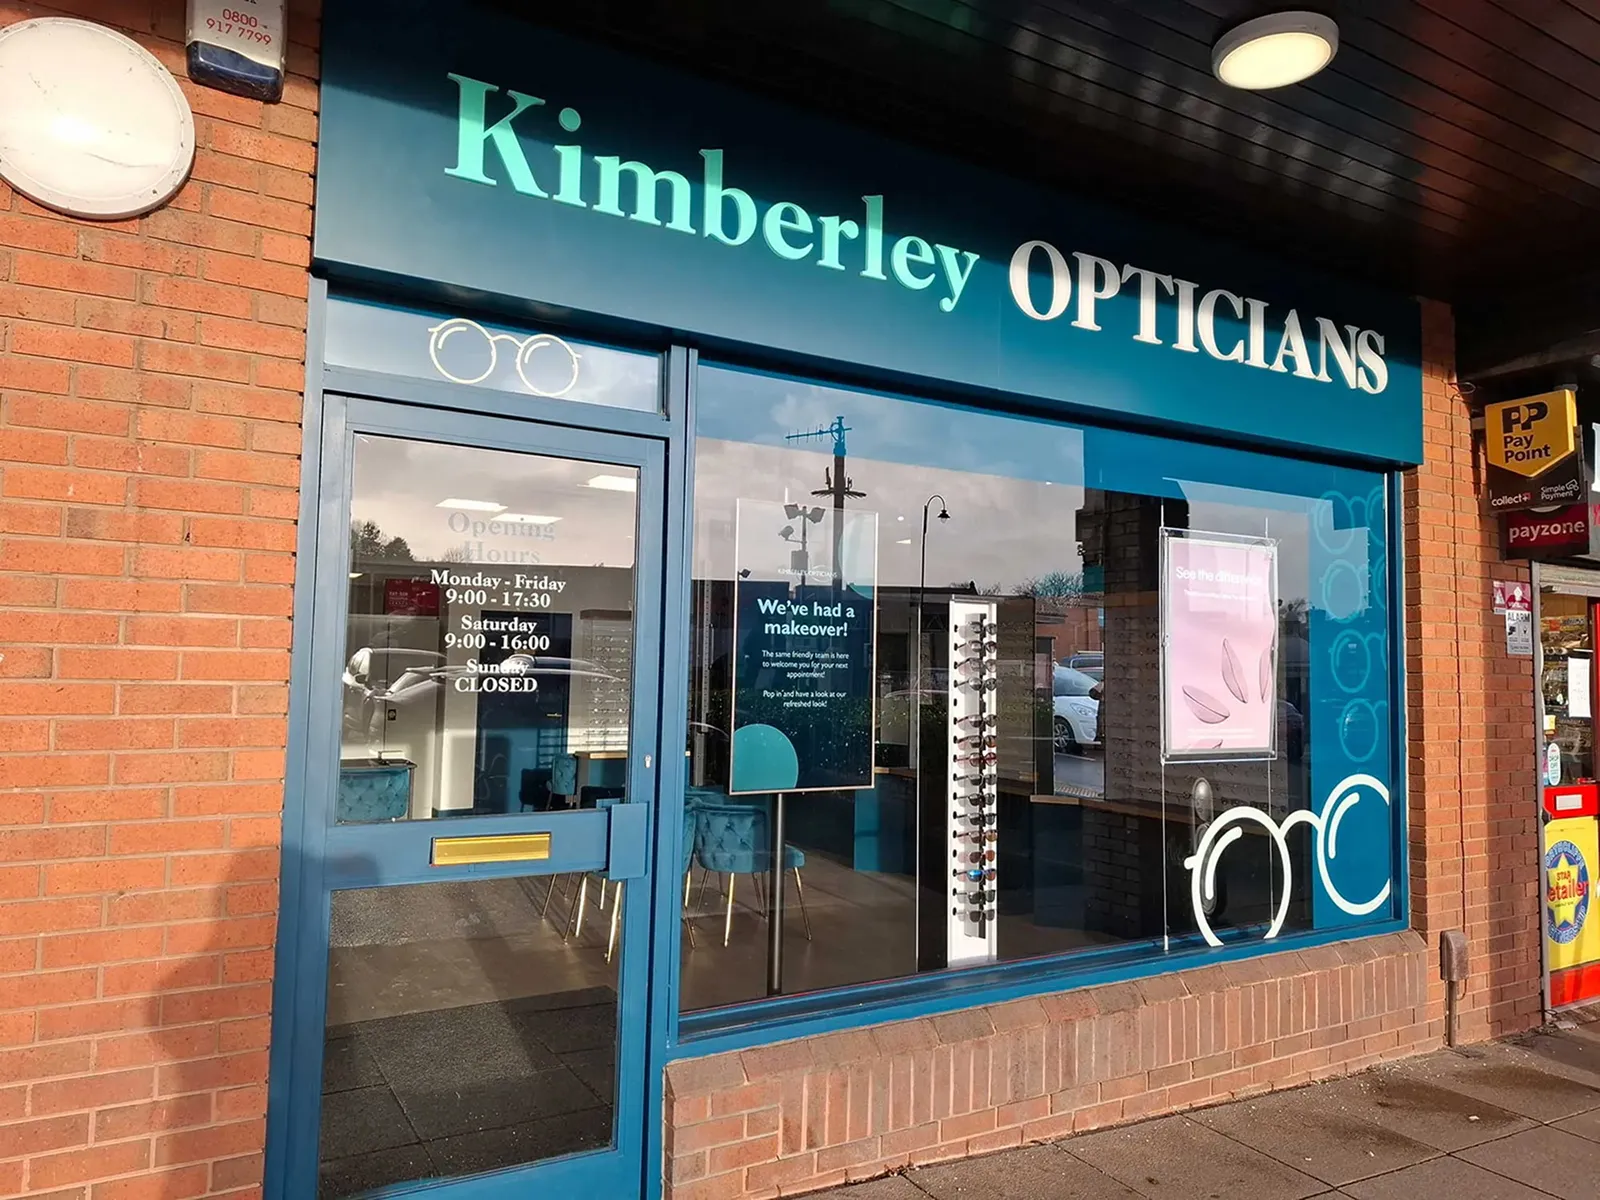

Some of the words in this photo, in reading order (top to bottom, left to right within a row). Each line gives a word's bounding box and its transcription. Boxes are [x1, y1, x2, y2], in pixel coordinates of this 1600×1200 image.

[223, 8, 258, 28] 0800
[206, 18, 232, 35] 917
[238, 27, 272, 45] 7799
[444, 72, 980, 312] Kimberley
[1009, 239, 1389, 394] OPTICIANS
[1503, 434, 1534, 450] Pay
[1505, 445, 1551, 463] Point
[1541, 484, 1565, 493] Simple
[1541, 490, 1573, 501] Payment
[448, 511, 557, 541] Opening
[1509, 521, 1585, 543] payzone
[464, 540, 541, 564] Hours
[430, 569, 502, 589] Monday
[515, 574, 566, 593] Friday
[1175, 566, 1197, 580] See
[1198, 568, 1213, 582] the
[445, 589, 487, 605] 9:00
[502, 592, 551, 608] 17:30
[813, 601, 841, 617] had
[845, 607, 855, 618] a
[461, 614, 537, 634] Saturday
[764, 620, 848, 637] makeover!
[444, 633, 486, 649] 9:00
[501, 635, 550, 650] 16:00
[762, 649, 774, 658] The
[792, 650, 813, 660] friendly
[830, 651, 835, 659] is
[836, 651, 850, 660] here
[466, 658, 530, 676] Sunday
[798, 662, 810, 670] you
[811, 661, 820, 669] for
[820, 662, 834, 670] your
[454, 677, 538, 693] CLOSED
[762, 689, 775, 699] Pop
[795, 690, 809, 698] have
[815, 690, 828, 698] look
[783, 700, 811, 708] refreshed
[812, 700, 828, 708] look!
[1556, 871, 1571, 882] STAR
[1547, 879, 1589, 902] etailer
